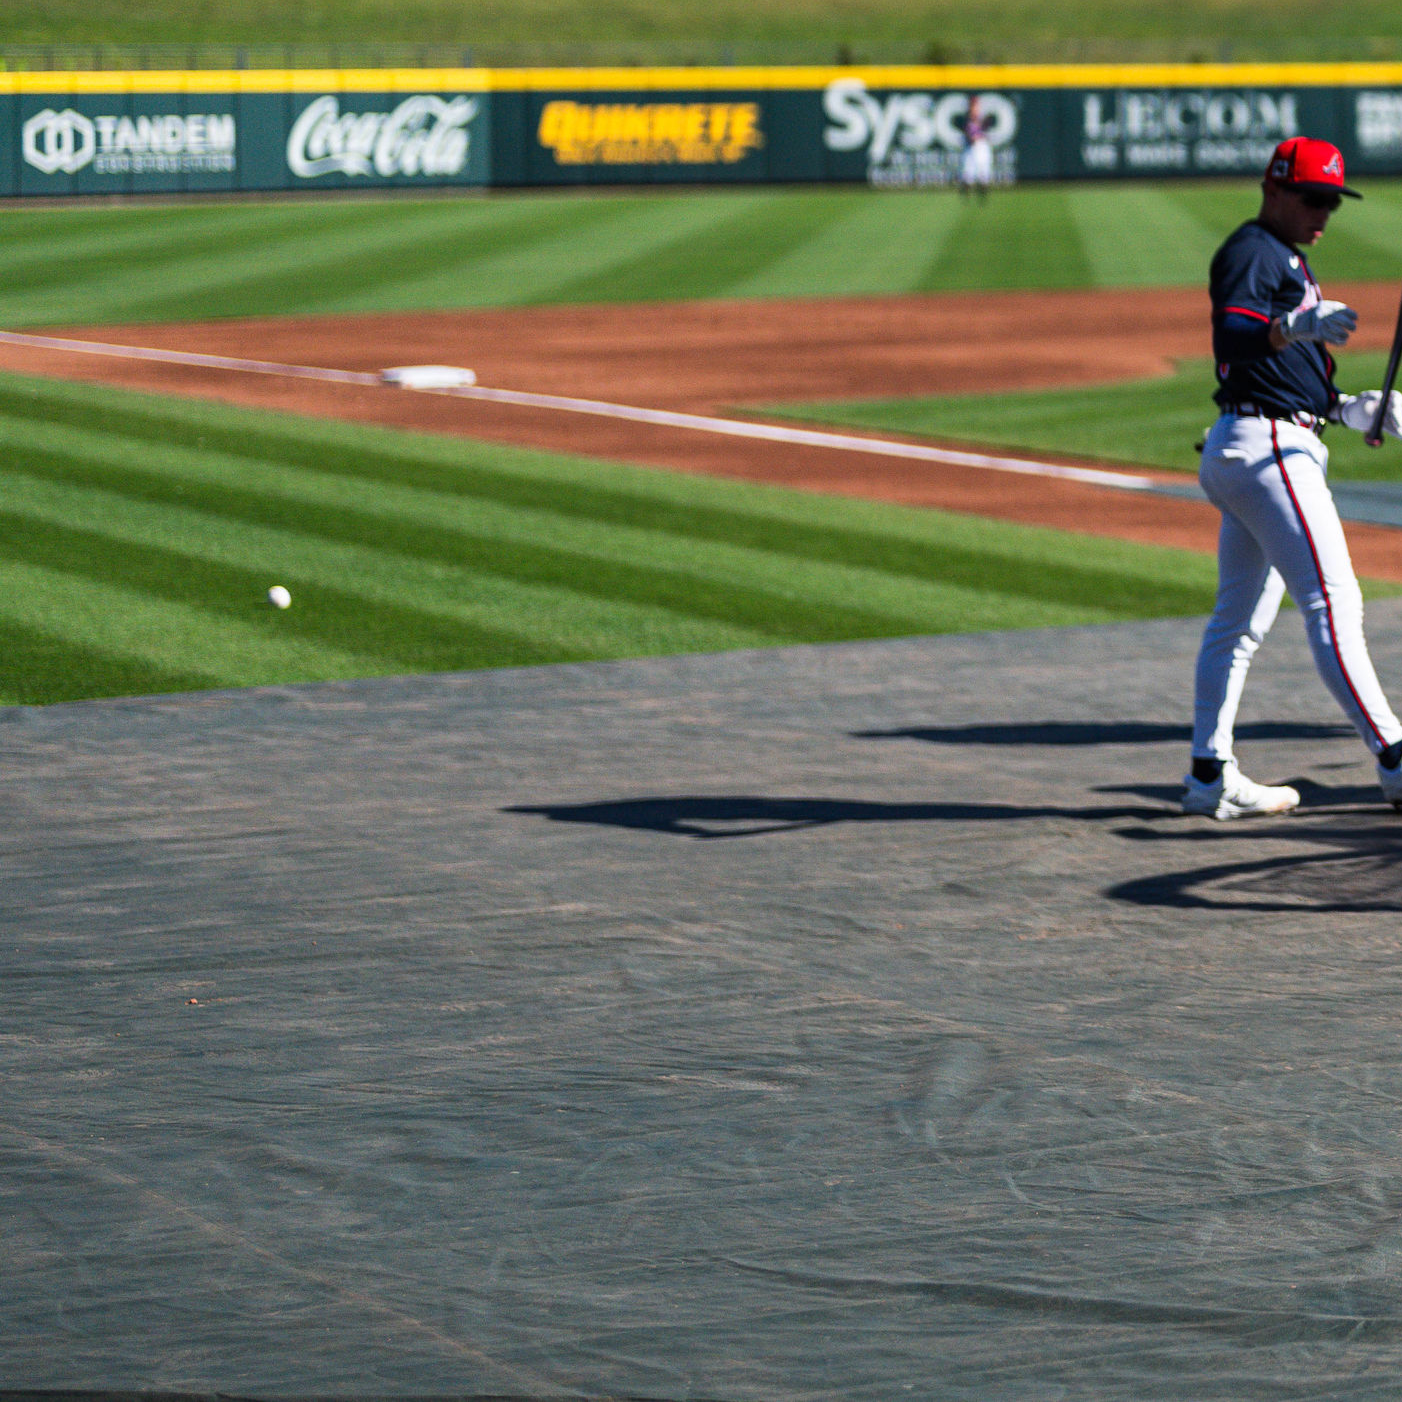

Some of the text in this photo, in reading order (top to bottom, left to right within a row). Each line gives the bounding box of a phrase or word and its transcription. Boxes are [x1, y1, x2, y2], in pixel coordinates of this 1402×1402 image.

[97, 114, 236, 149] TANDEM
[823, 79, 1018, 161] Sysco
[1083, 92, 1298, 141] LECOM
